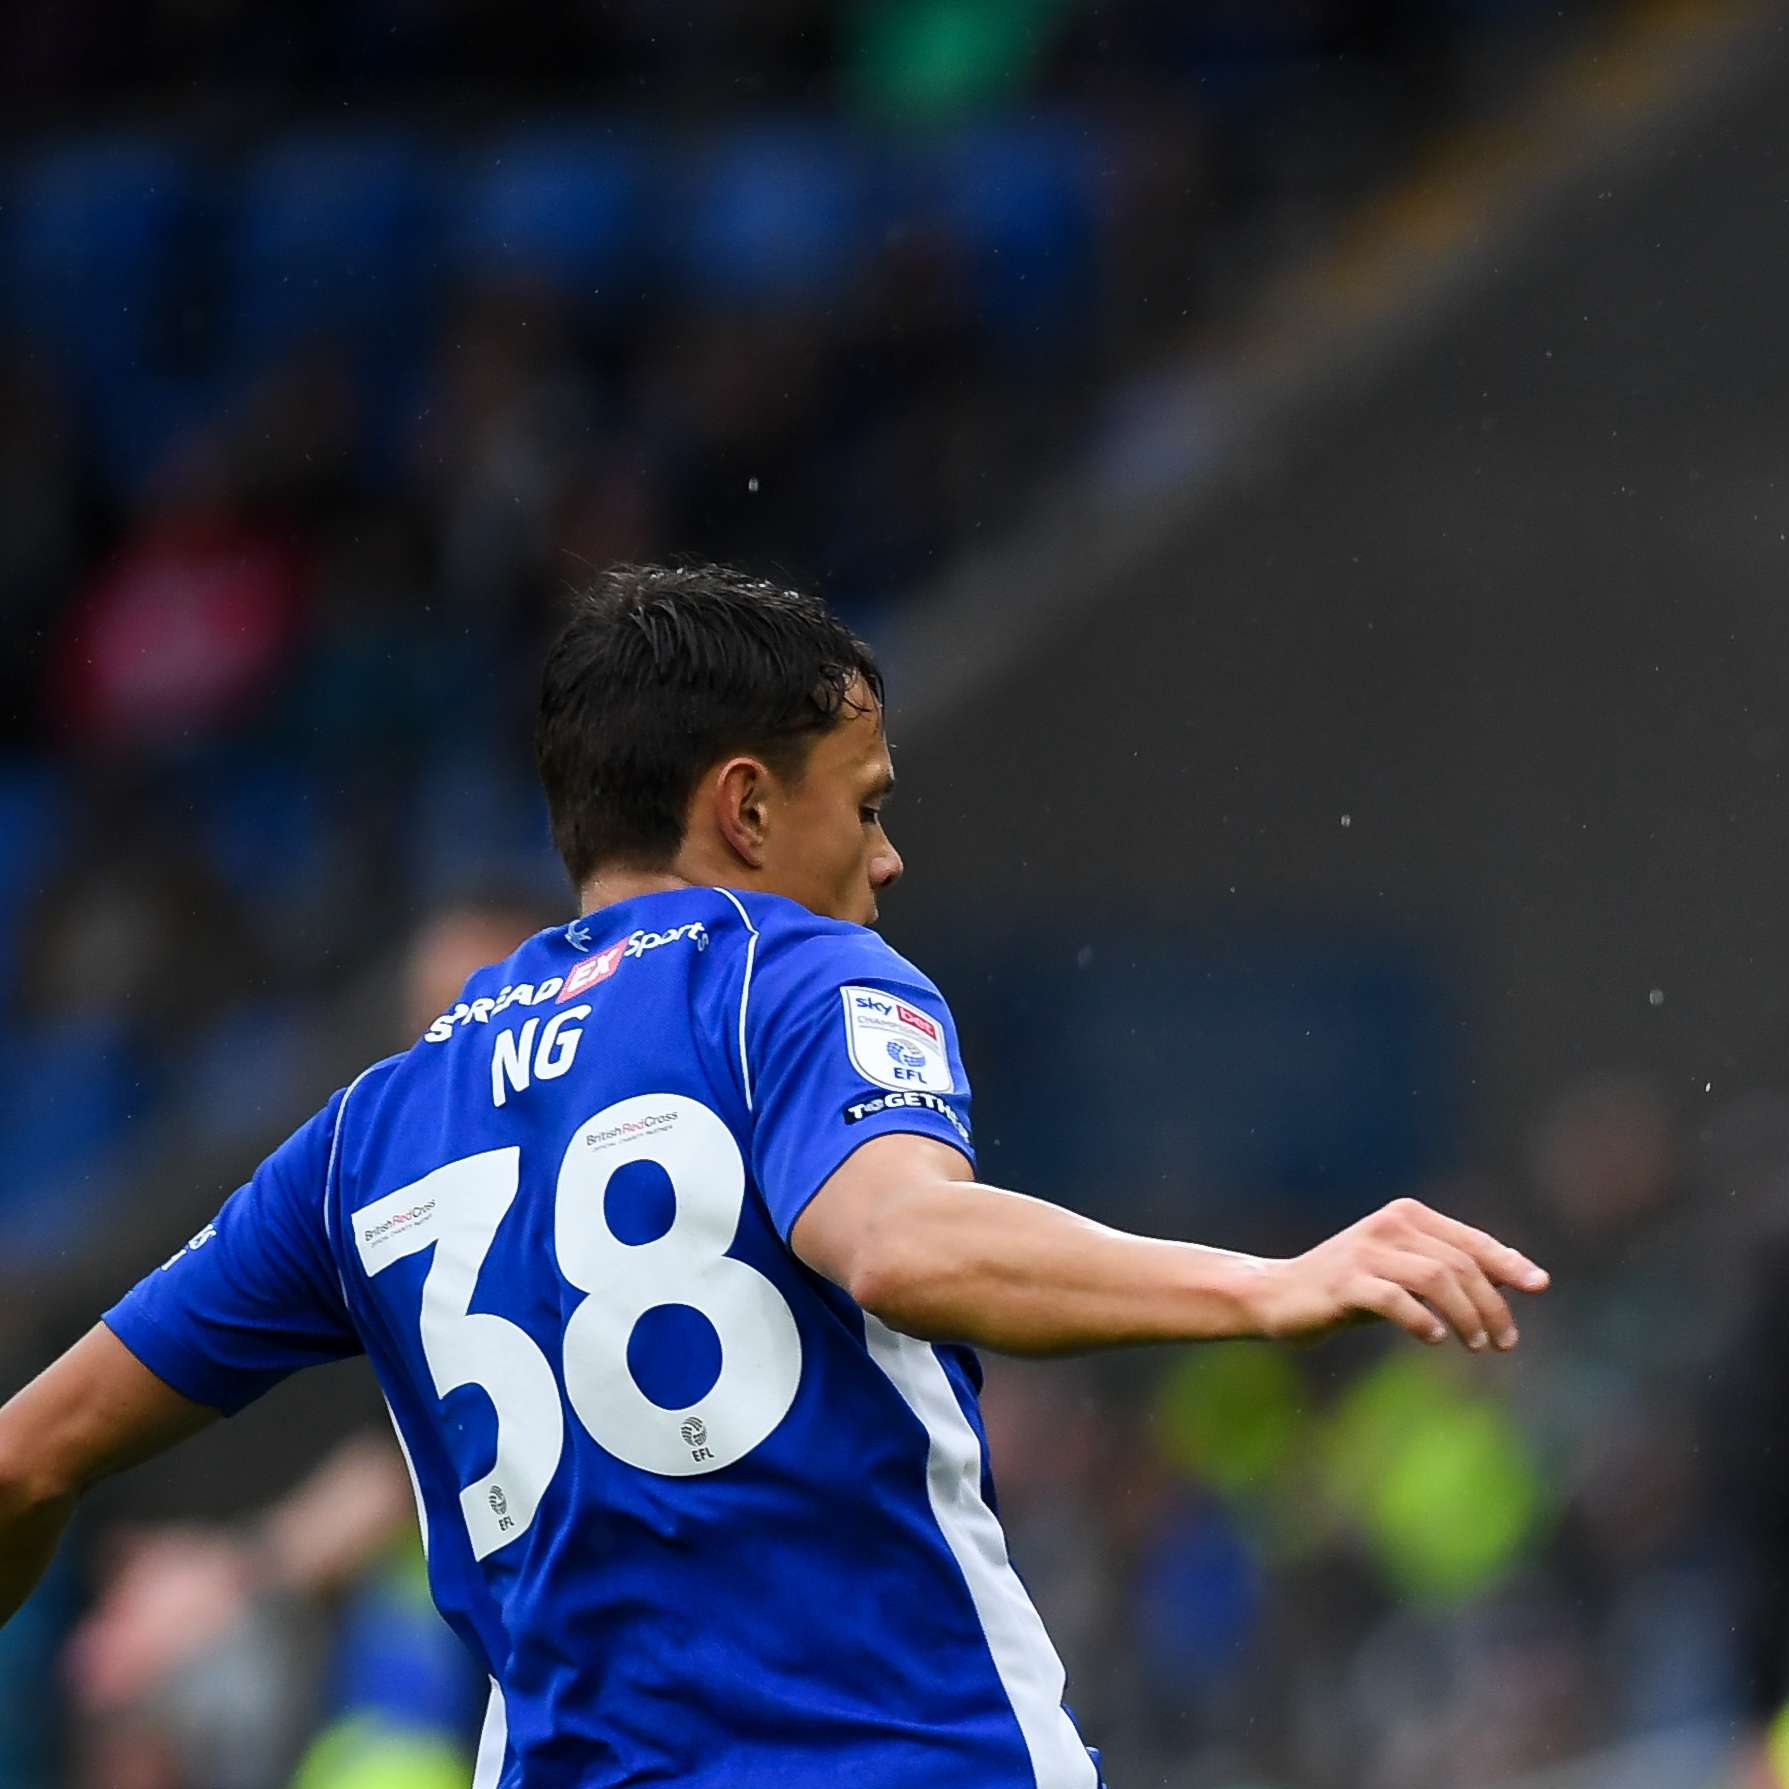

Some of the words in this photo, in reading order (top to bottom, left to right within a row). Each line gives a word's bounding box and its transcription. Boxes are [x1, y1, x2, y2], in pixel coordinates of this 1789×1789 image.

[855, 997, 893, 1016] sky
[491, 1004, 592, 1107] NG
[893, 1067, 928, 1084] EFL
[351, 1093, 802, 1562] 38
[691, 1447, 715, 1462] EFL
[498, 1516, 515, 1531] EFL
